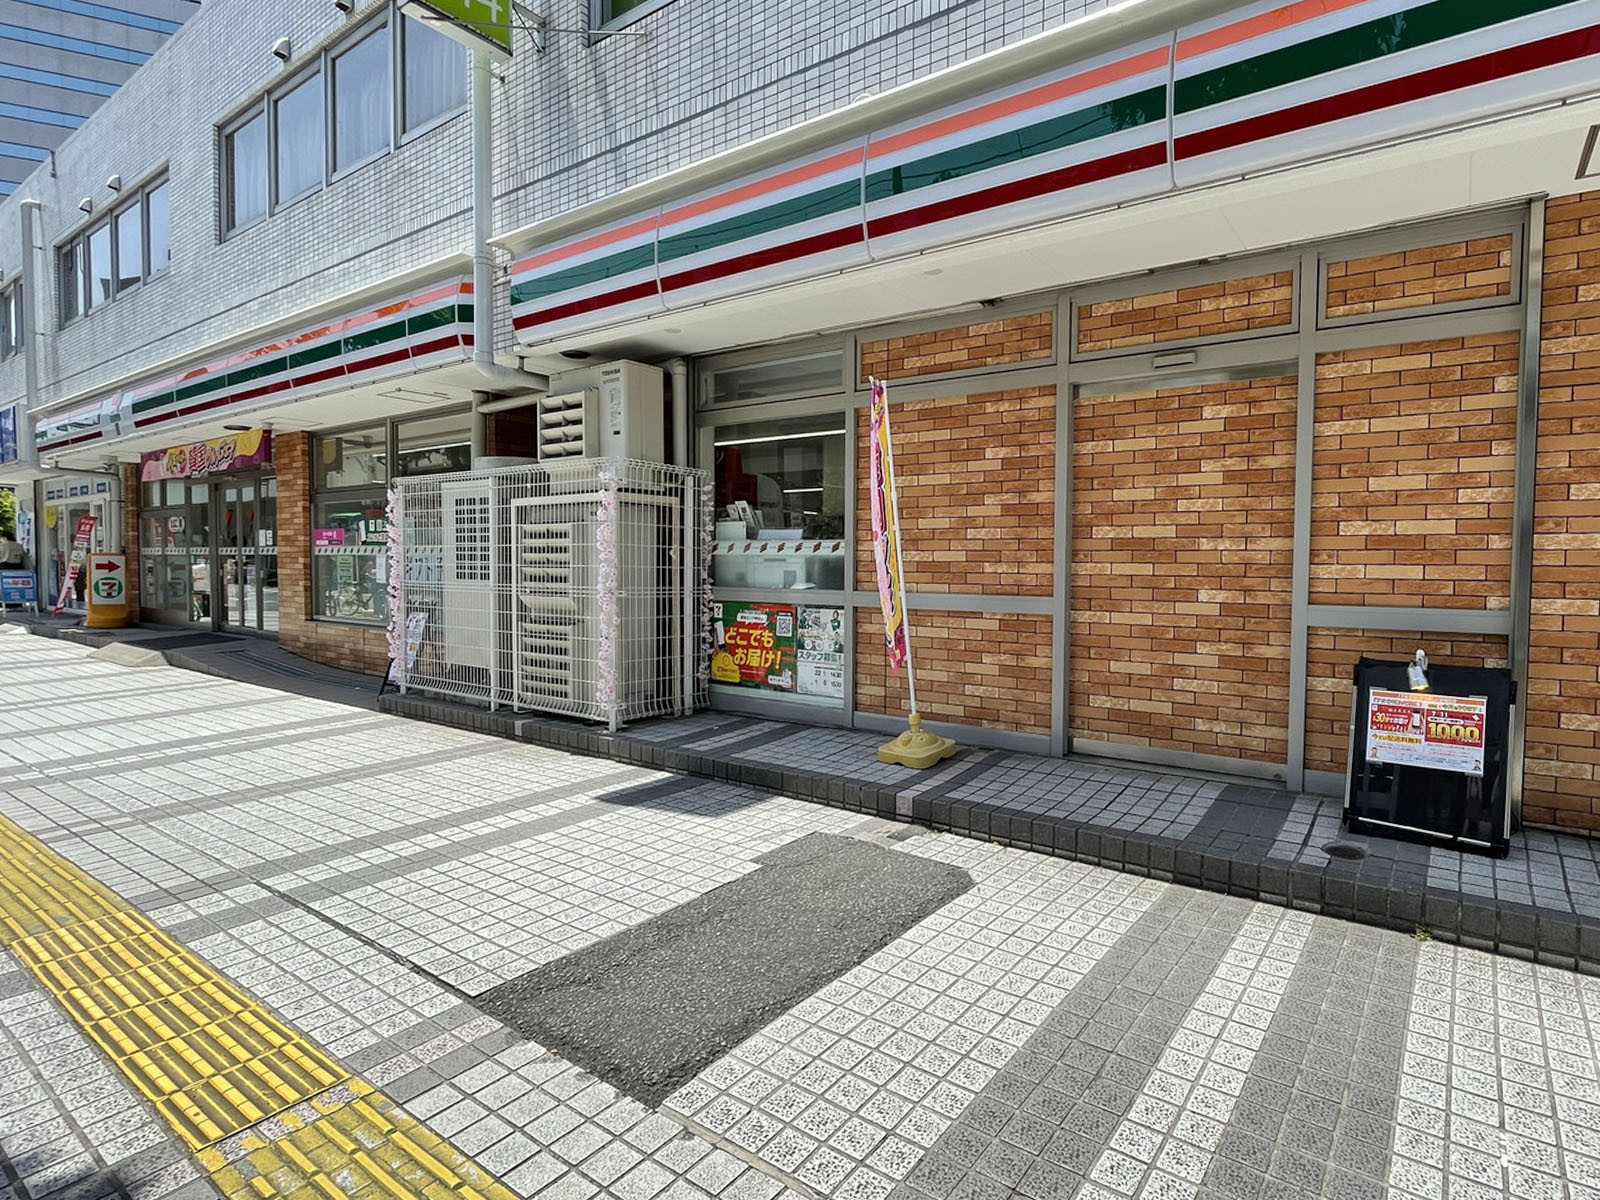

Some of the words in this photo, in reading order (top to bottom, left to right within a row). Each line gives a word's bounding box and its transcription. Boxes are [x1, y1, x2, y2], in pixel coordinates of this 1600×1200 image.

[601, 368, 621, 376] TOSHIBA
[725, 626, 774, 648] どこでも
